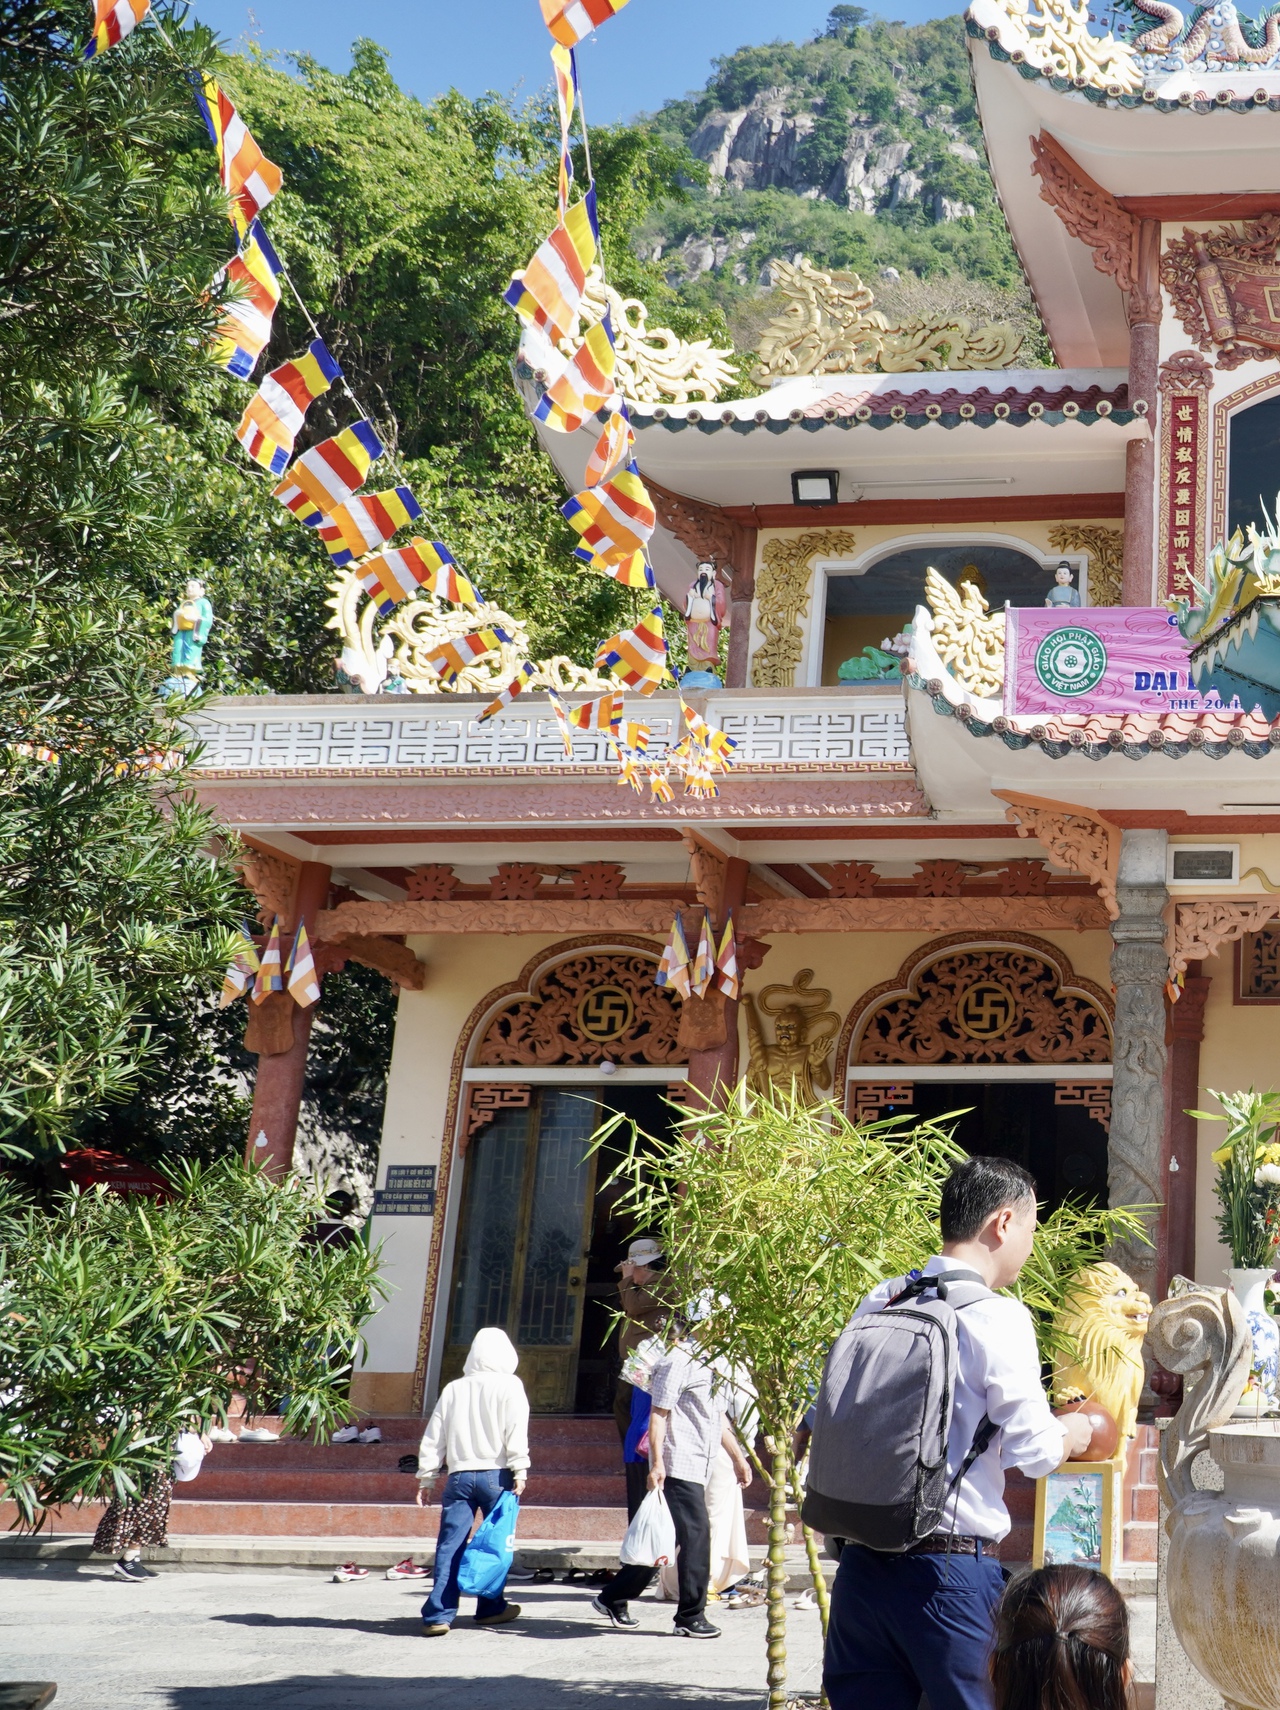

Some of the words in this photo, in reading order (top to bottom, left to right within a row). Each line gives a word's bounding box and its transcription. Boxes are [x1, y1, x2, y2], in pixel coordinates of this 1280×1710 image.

[1040, 647, 1051, 671] GIÁO
[1049, 633, 1067, 647] HỘI
[1068, 632, 1094, 647] PHẬT
[1091, 646, 1103, 671] GIÁO
[1051, 677, 1069, 691] VIỆT
[1069, 678, 1090, 691] NAM
[1134, 671, 1178, 697] ĐẠI
[1168, 699, 1198, 709] THE
